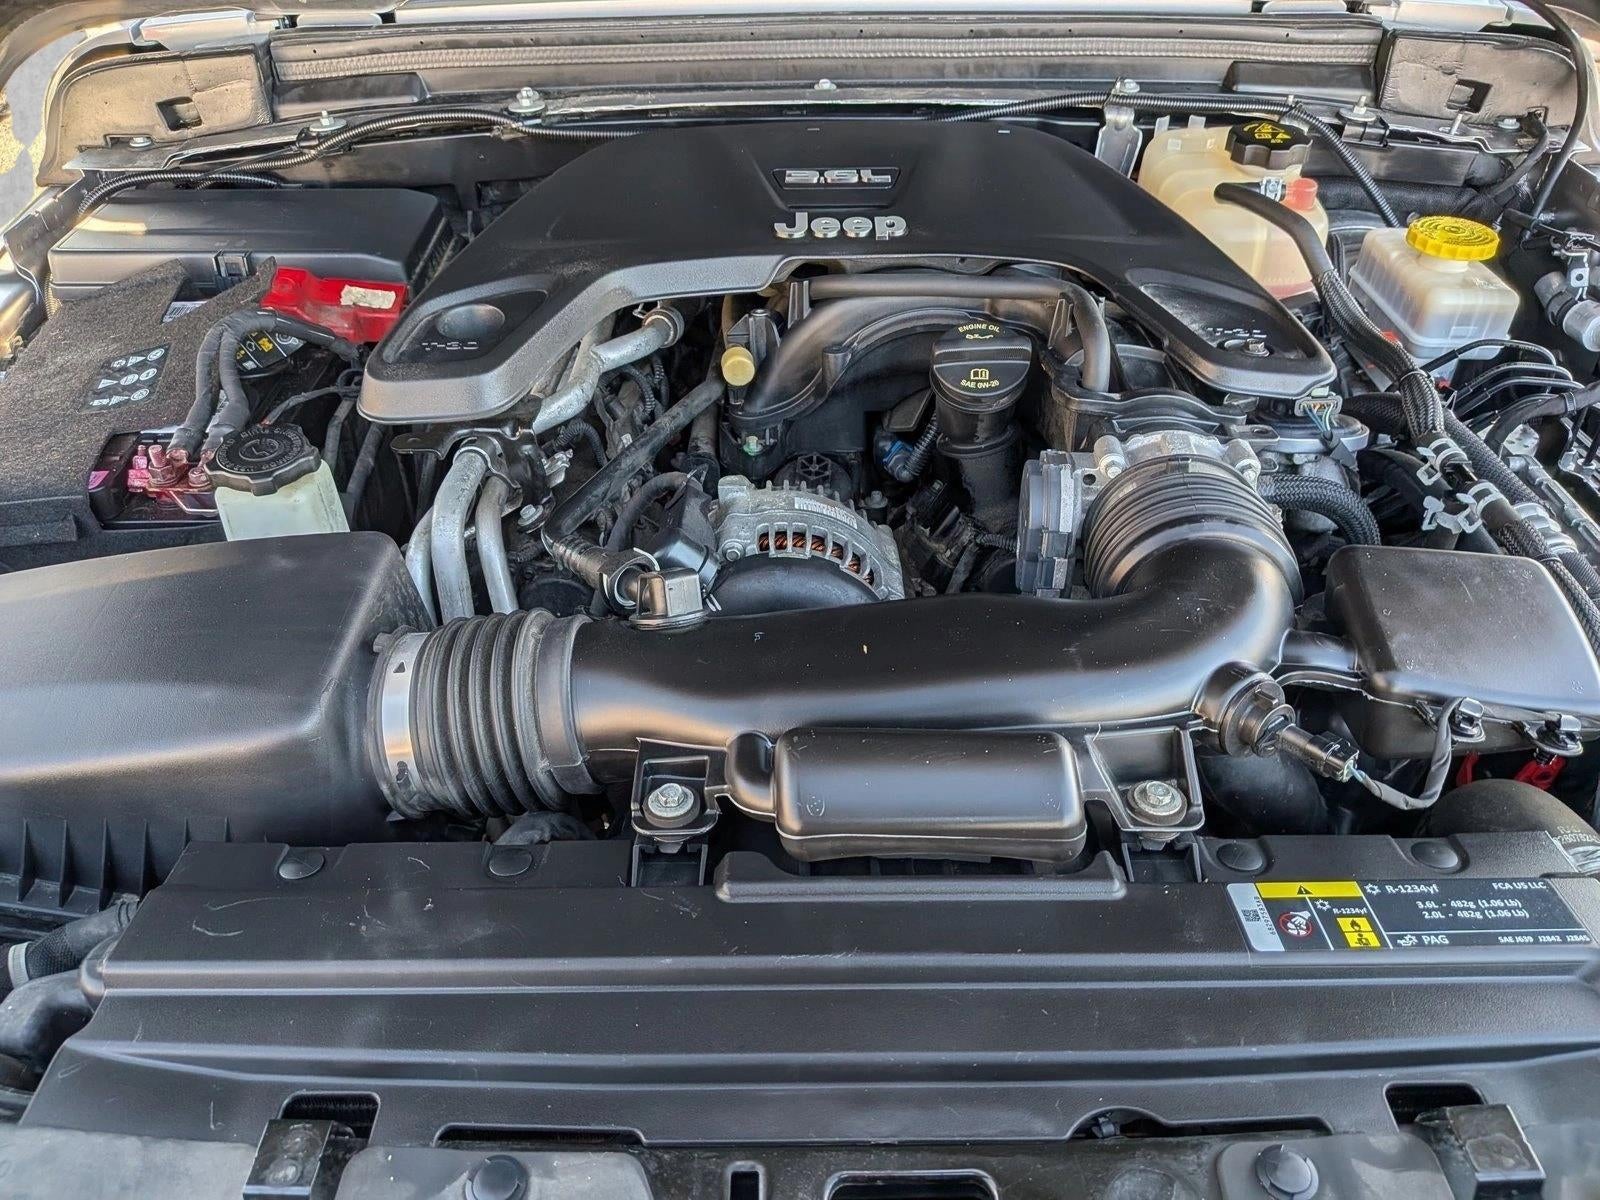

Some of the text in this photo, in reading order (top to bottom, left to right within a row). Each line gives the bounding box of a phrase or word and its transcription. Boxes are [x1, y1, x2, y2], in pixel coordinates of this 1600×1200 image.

[774, 211, 907, 241] Jeep
[957, 323, 1001, 333] ENGINE OIL
[960, 379, 1000, 389] SAE 0W-20
[1384, 883, 1440, 894] R-1234yf
[1491, 881, 1547, 890] FCA US LLC
[1415, 900, 1439, 909] 3.6L
[1450, 900, 1477, 909] 482g
[1477, 899, 1504, 908] (1.06
[1503, 899, 1522, 908] Lb)
[1332, 906, 1369, 915] R-1234yf
[1422, 910, 1446, 919] 2.0L
[1457, 910, 1483, 919] 482g
[1484, 909, 1511, 919] (1.06
[1510, 908, 1530, 919] Lb)
[1421, 935, 1450, 944] PAG
[1498, 935, 1515, 943] SAE
